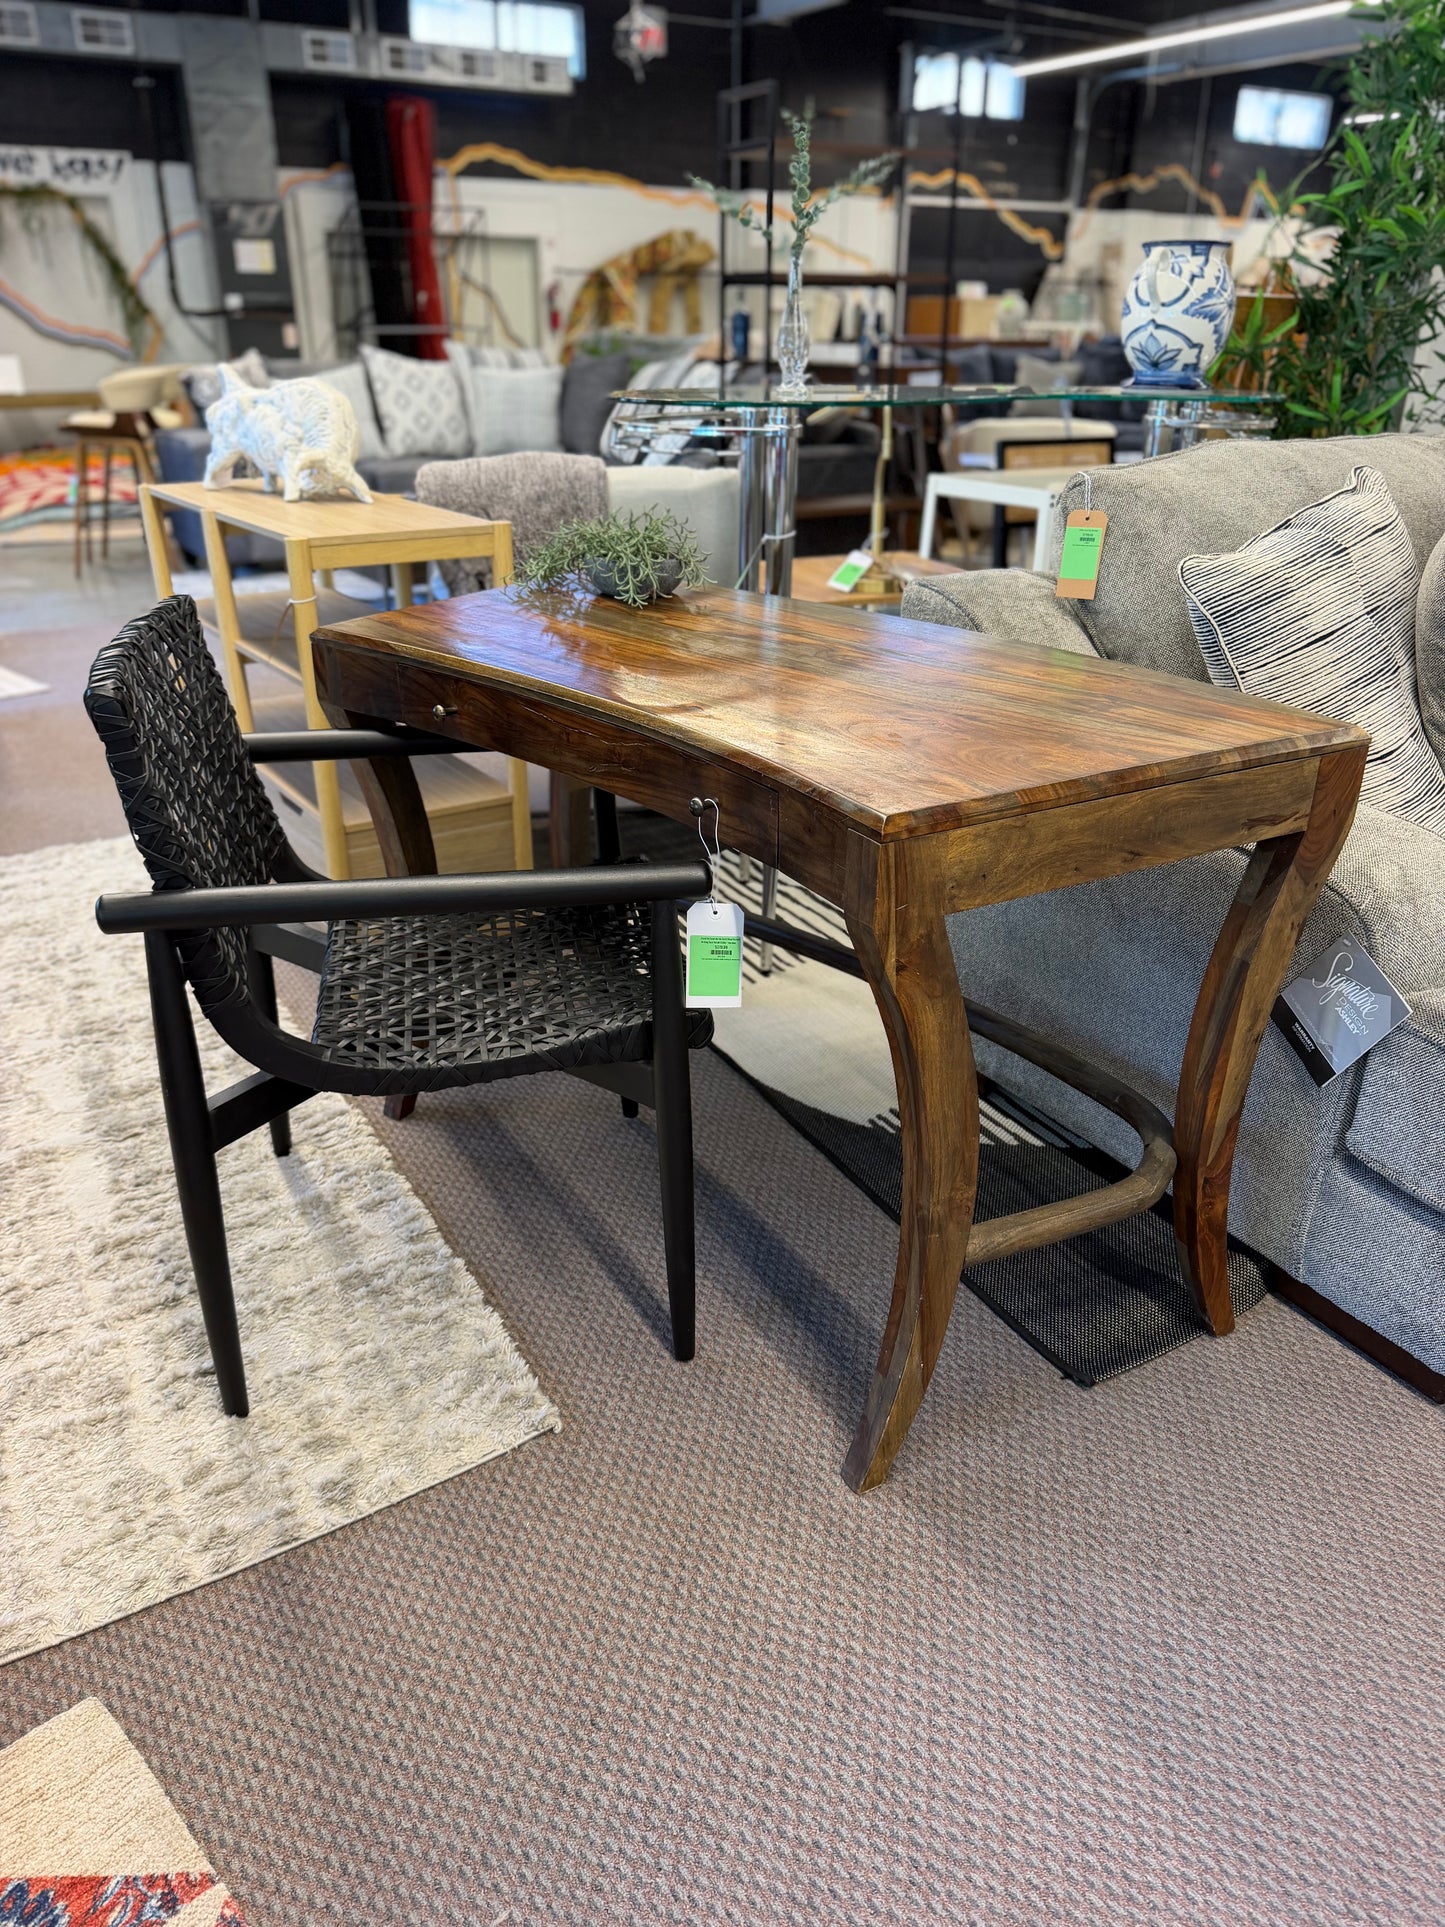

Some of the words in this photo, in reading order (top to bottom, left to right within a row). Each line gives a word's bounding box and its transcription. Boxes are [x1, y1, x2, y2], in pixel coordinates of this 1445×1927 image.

[1312, 951, 1379, 1020] Signature
[1334, 1006, 1361, 1035] ASHLEY
[1336, 996, 1369, 1035] DESIGN
